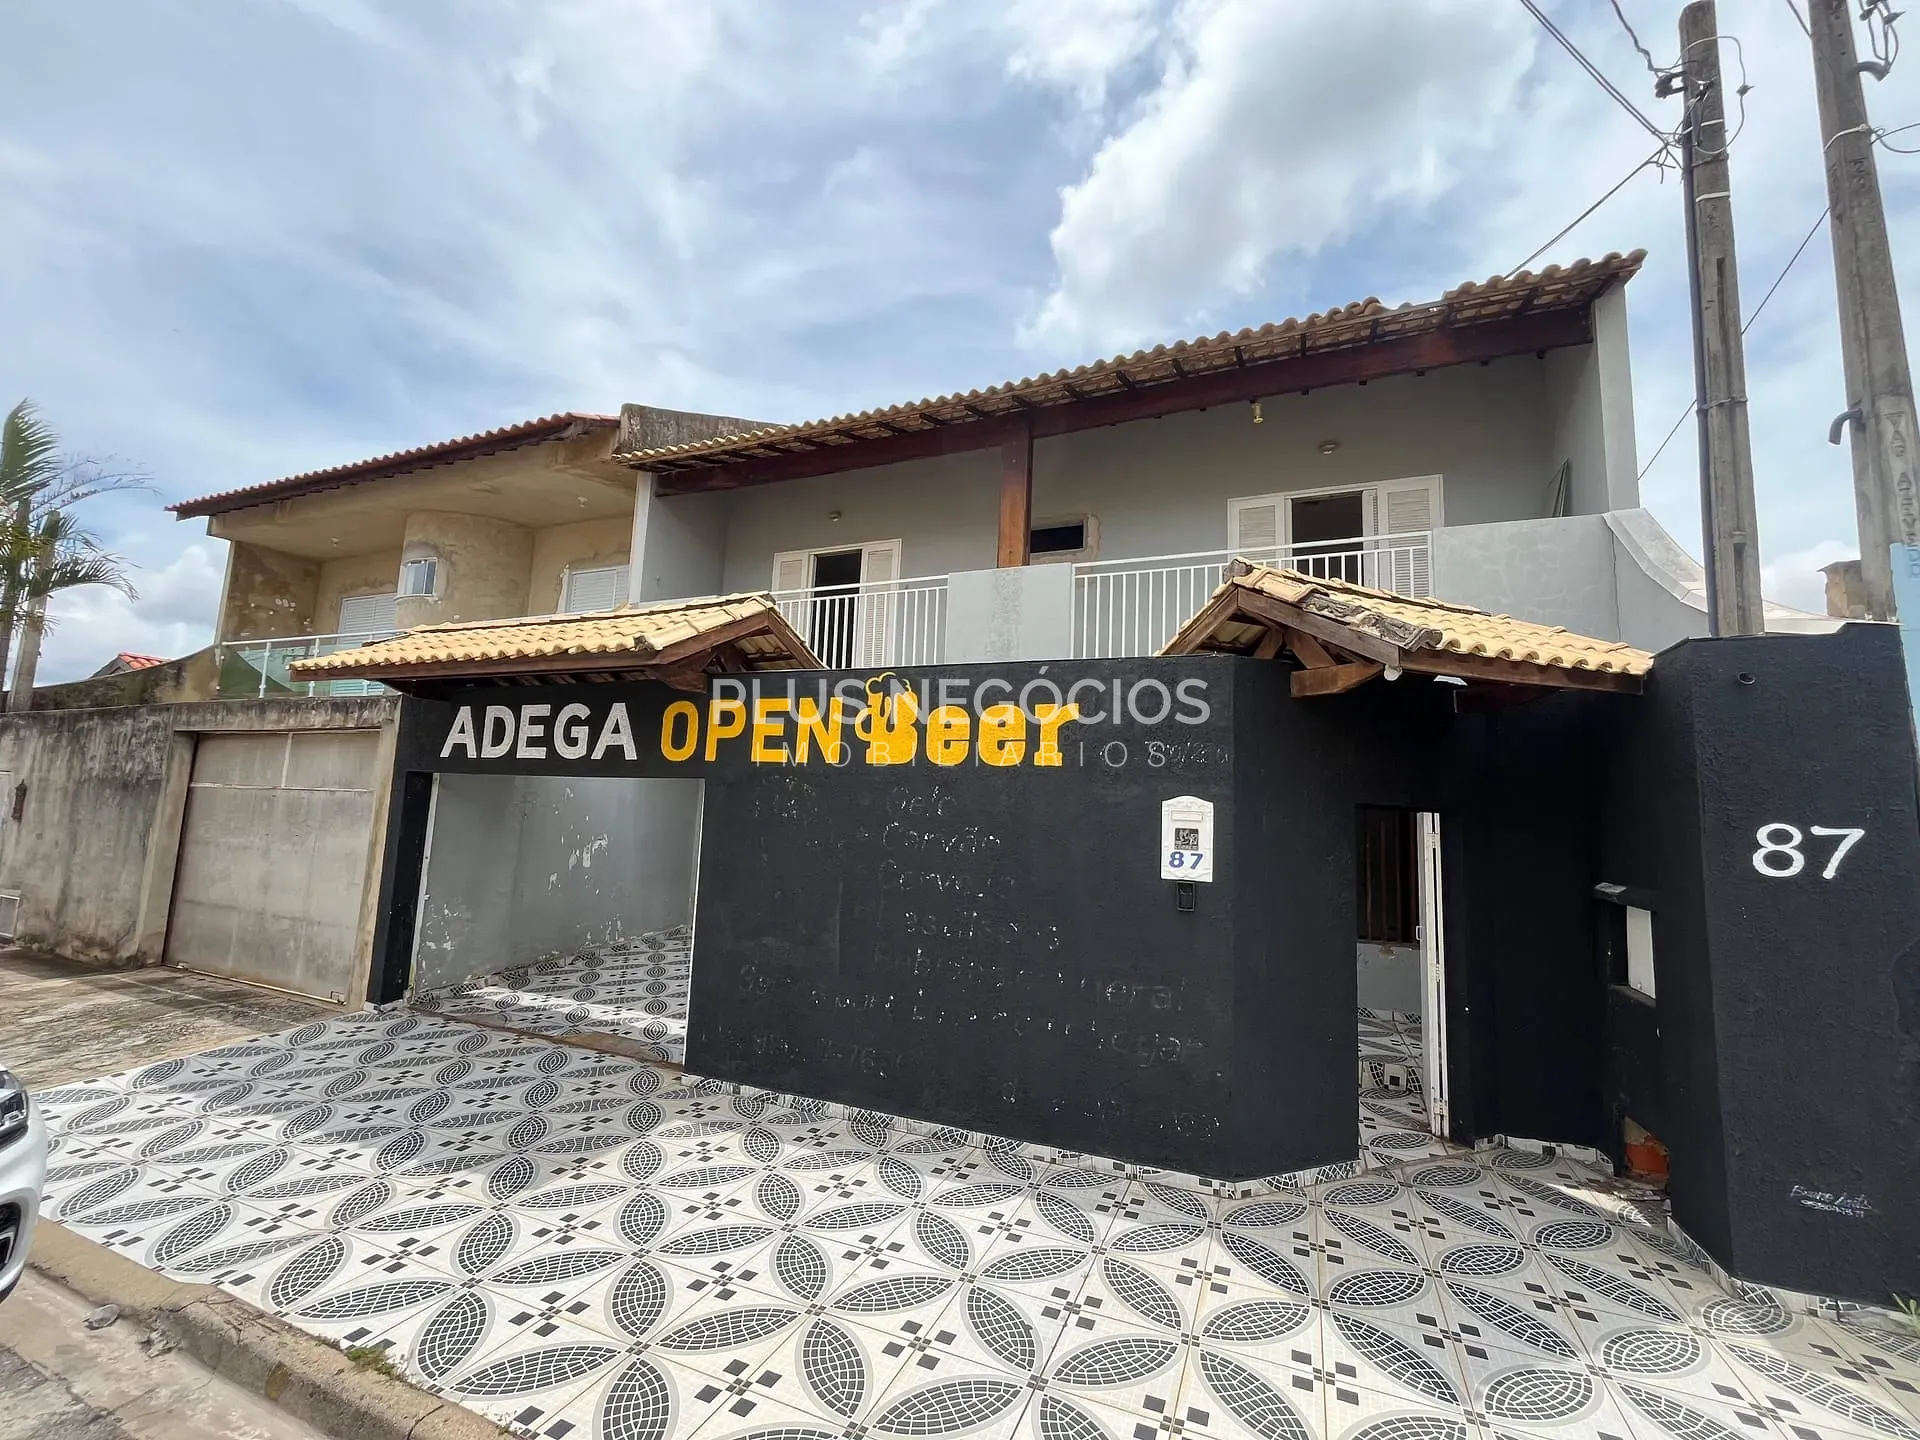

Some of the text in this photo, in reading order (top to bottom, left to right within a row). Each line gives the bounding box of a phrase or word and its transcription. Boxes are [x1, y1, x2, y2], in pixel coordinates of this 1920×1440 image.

[439, 702, 638, 760] ADEGA
[660, 697, 843, 764] OPEN
[855, 673, 1080, 767] Beer
[1168, 851, 1204, 870] 87
[1752, 822, 1865, 880] 87
